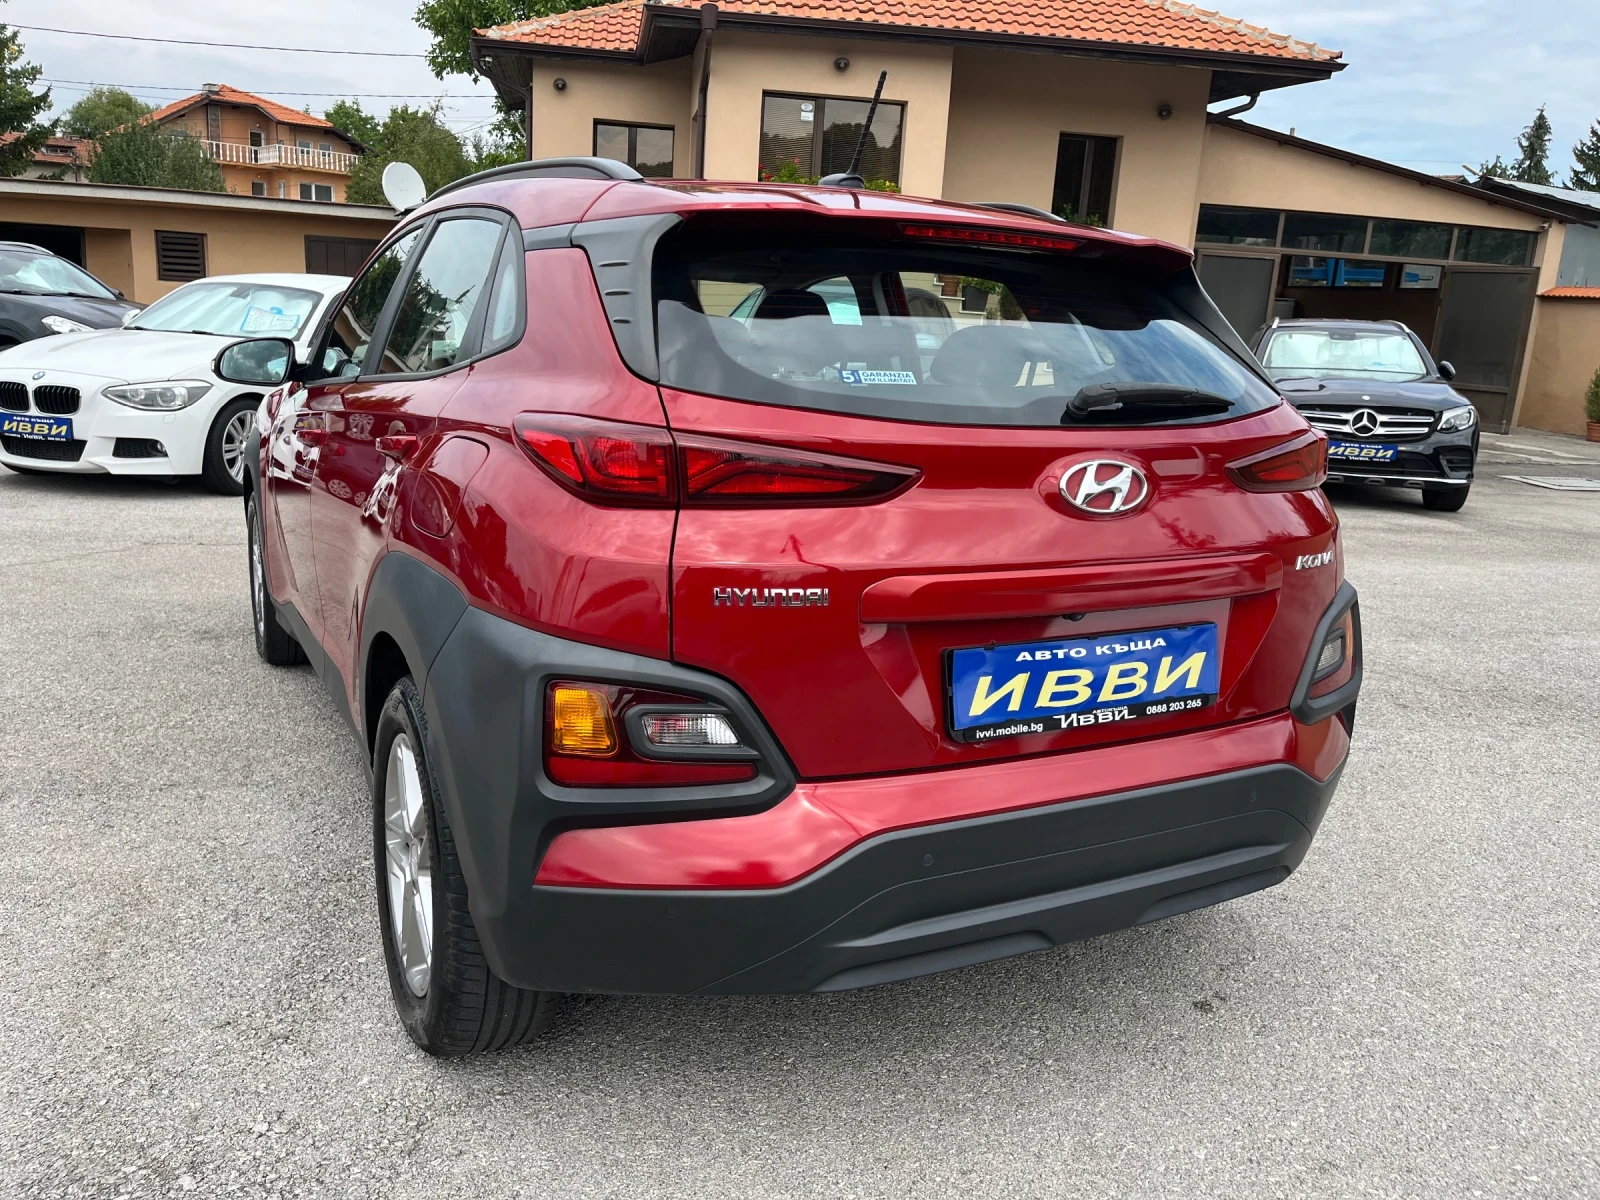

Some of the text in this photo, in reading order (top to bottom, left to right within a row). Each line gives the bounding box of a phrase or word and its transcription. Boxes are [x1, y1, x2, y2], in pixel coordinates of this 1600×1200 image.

[3, 420, 68, 436] ИВВИ
[1328, 446, 1395, 458] ИВВИ
[713, 587, 829, 607] HYUNDAI
[1016, 637, 1167, 662] АВТО КЪЩА
[969, 651, 1207, 717] ИВВИ
[1146, 698, 1202, 715] 0888 203 265
[976, 722, 1044, 739] ivvi.mobile.bg
